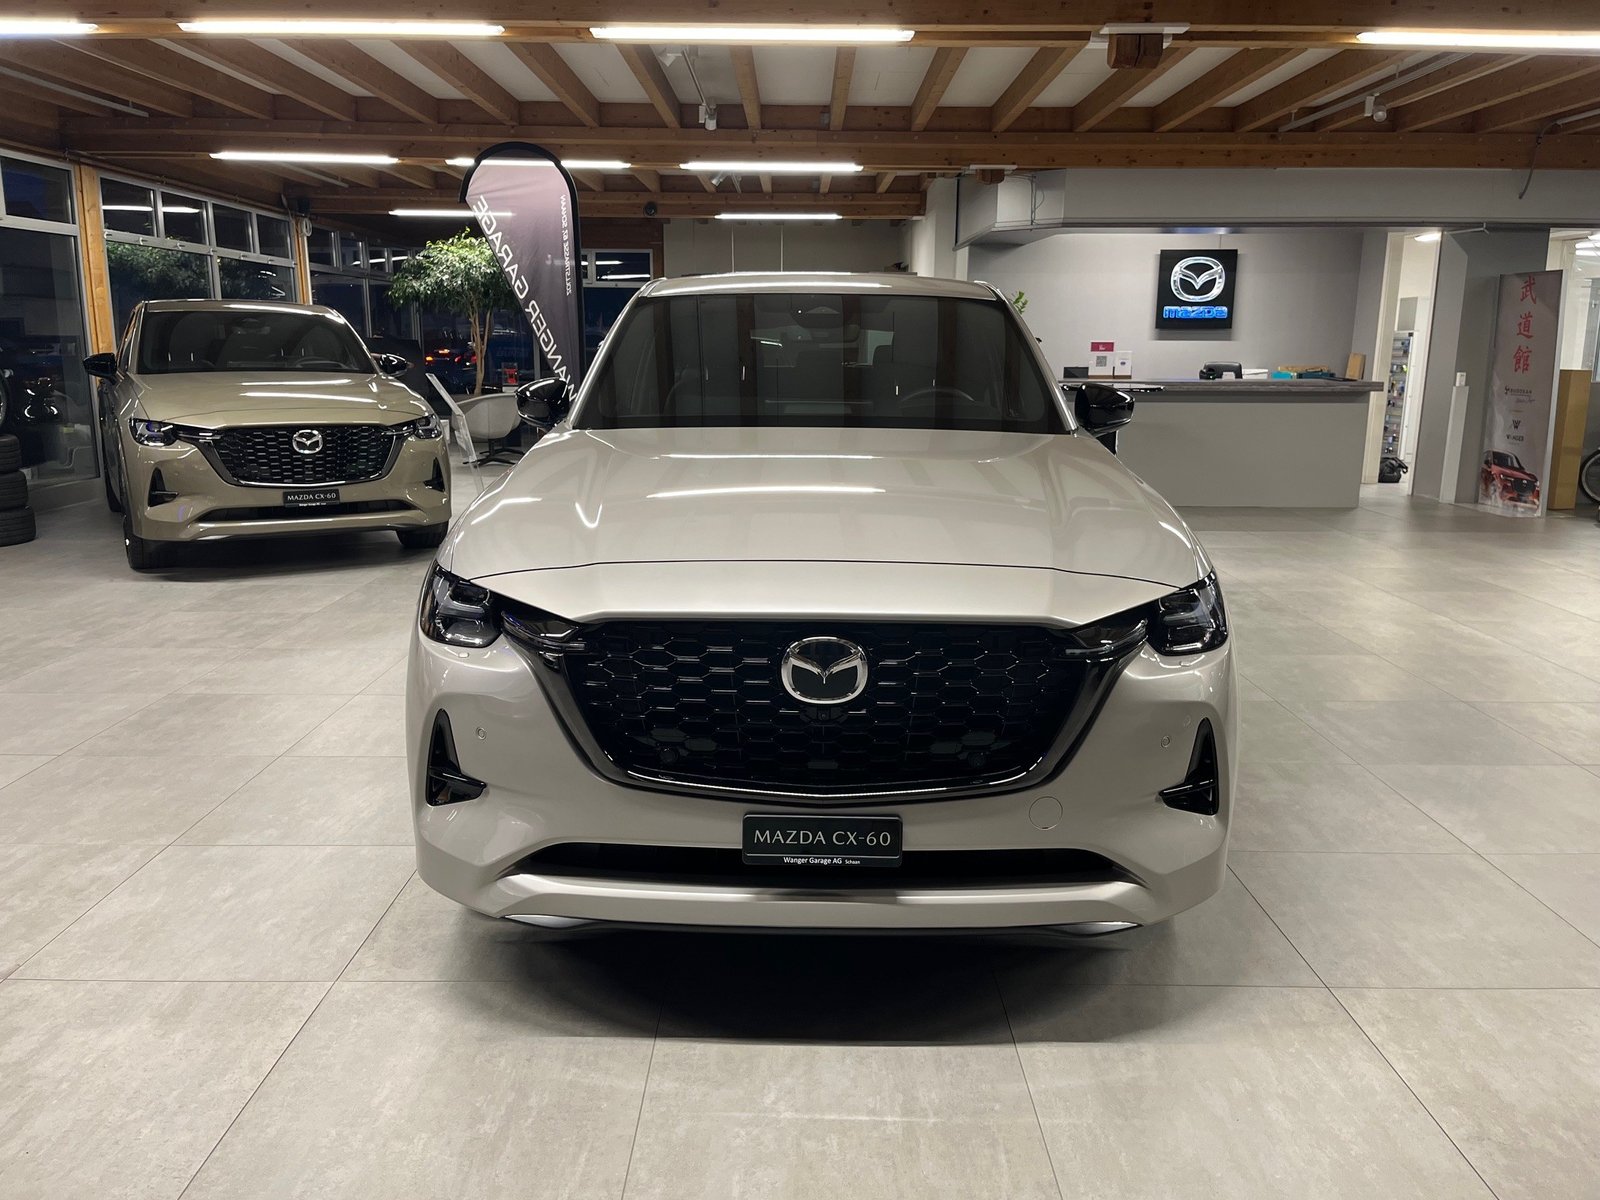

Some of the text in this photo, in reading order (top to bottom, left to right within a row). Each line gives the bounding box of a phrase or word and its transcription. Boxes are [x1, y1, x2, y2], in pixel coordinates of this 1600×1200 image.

[1513, 276, 1537, 373] 武道館
[754, 830, 891, 846] MAZDA CX-60
[783, 857, 808, 865] Wanger
[809, 857, 832, 866] Garage
[832, 857, 843, 865] AG
